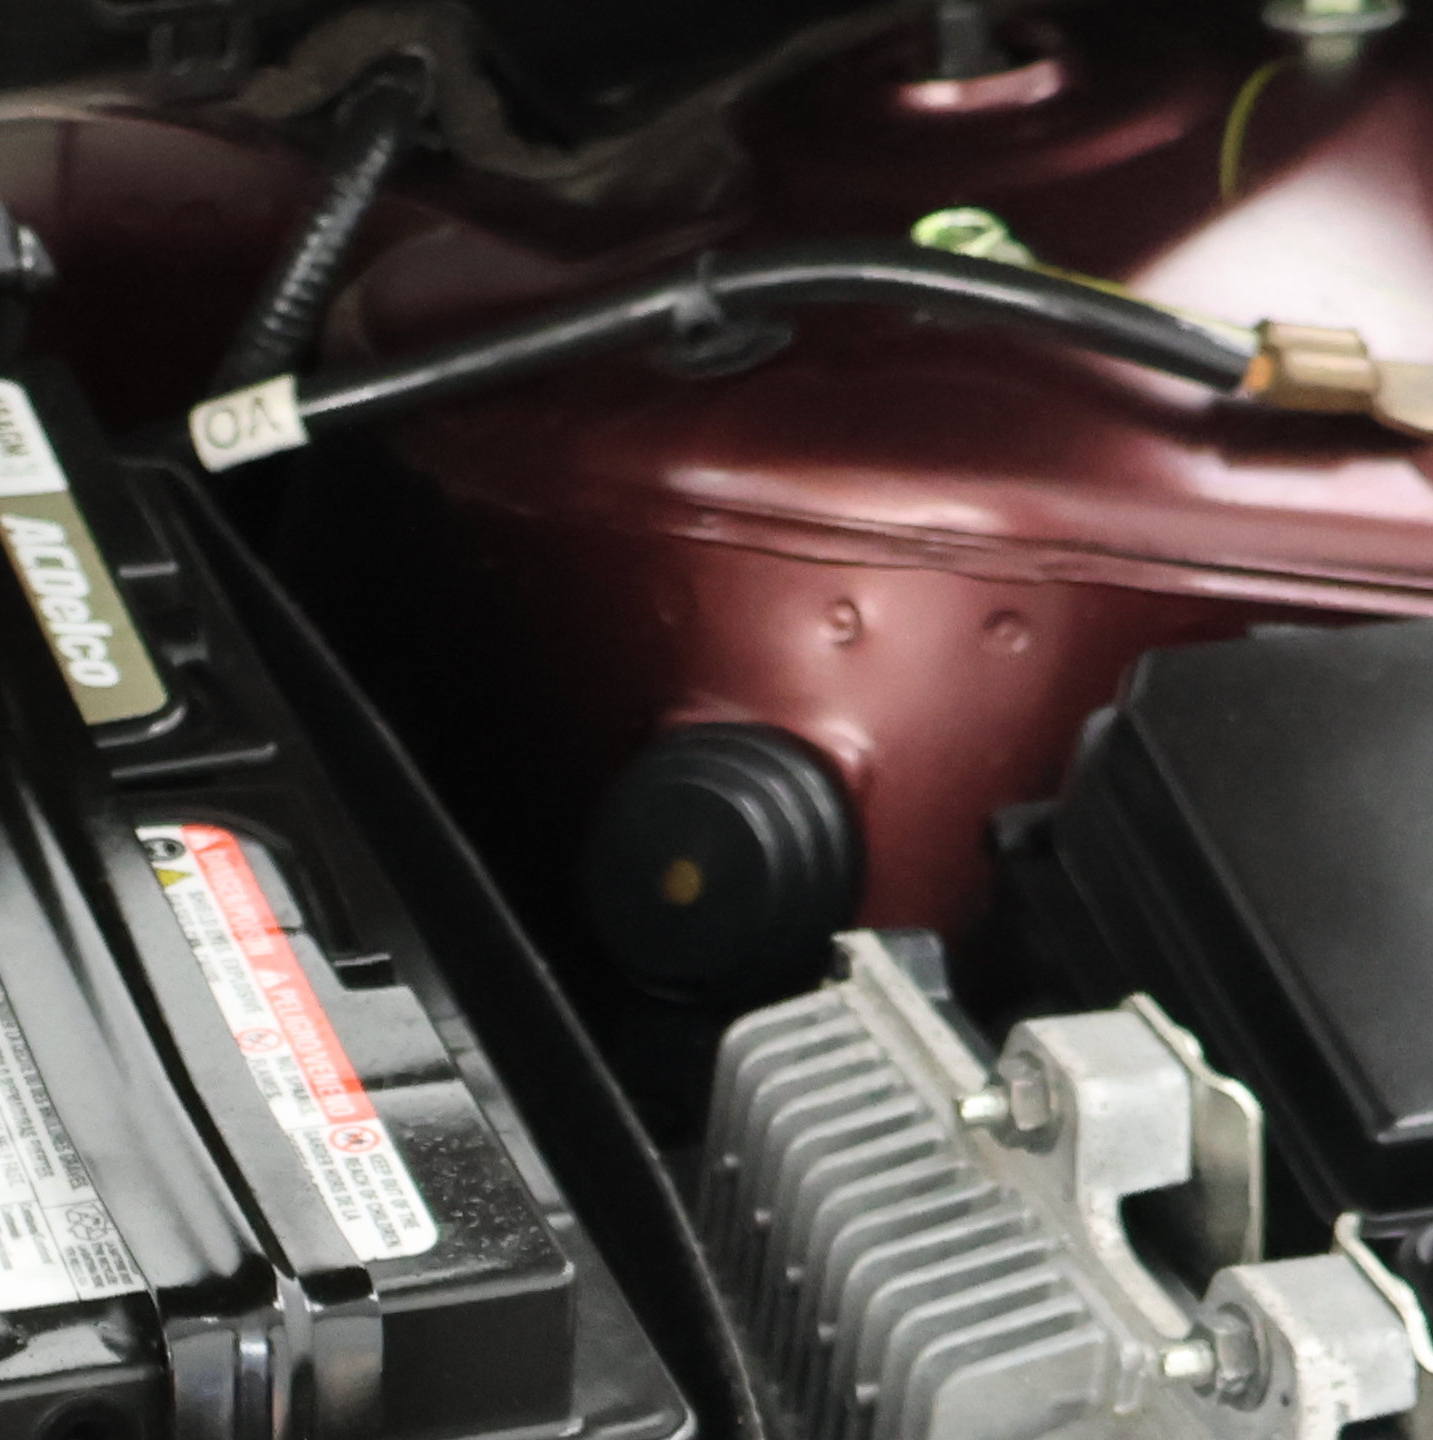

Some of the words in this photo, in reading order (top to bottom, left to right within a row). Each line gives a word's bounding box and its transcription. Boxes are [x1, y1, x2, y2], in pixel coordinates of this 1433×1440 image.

[342, 1157, 372, 1188] REACH
[366, 1152, 393, 1179] KEEP
[378, 1177, 403, 1198] OUT
[397, 1211, 422, 1231] THE
